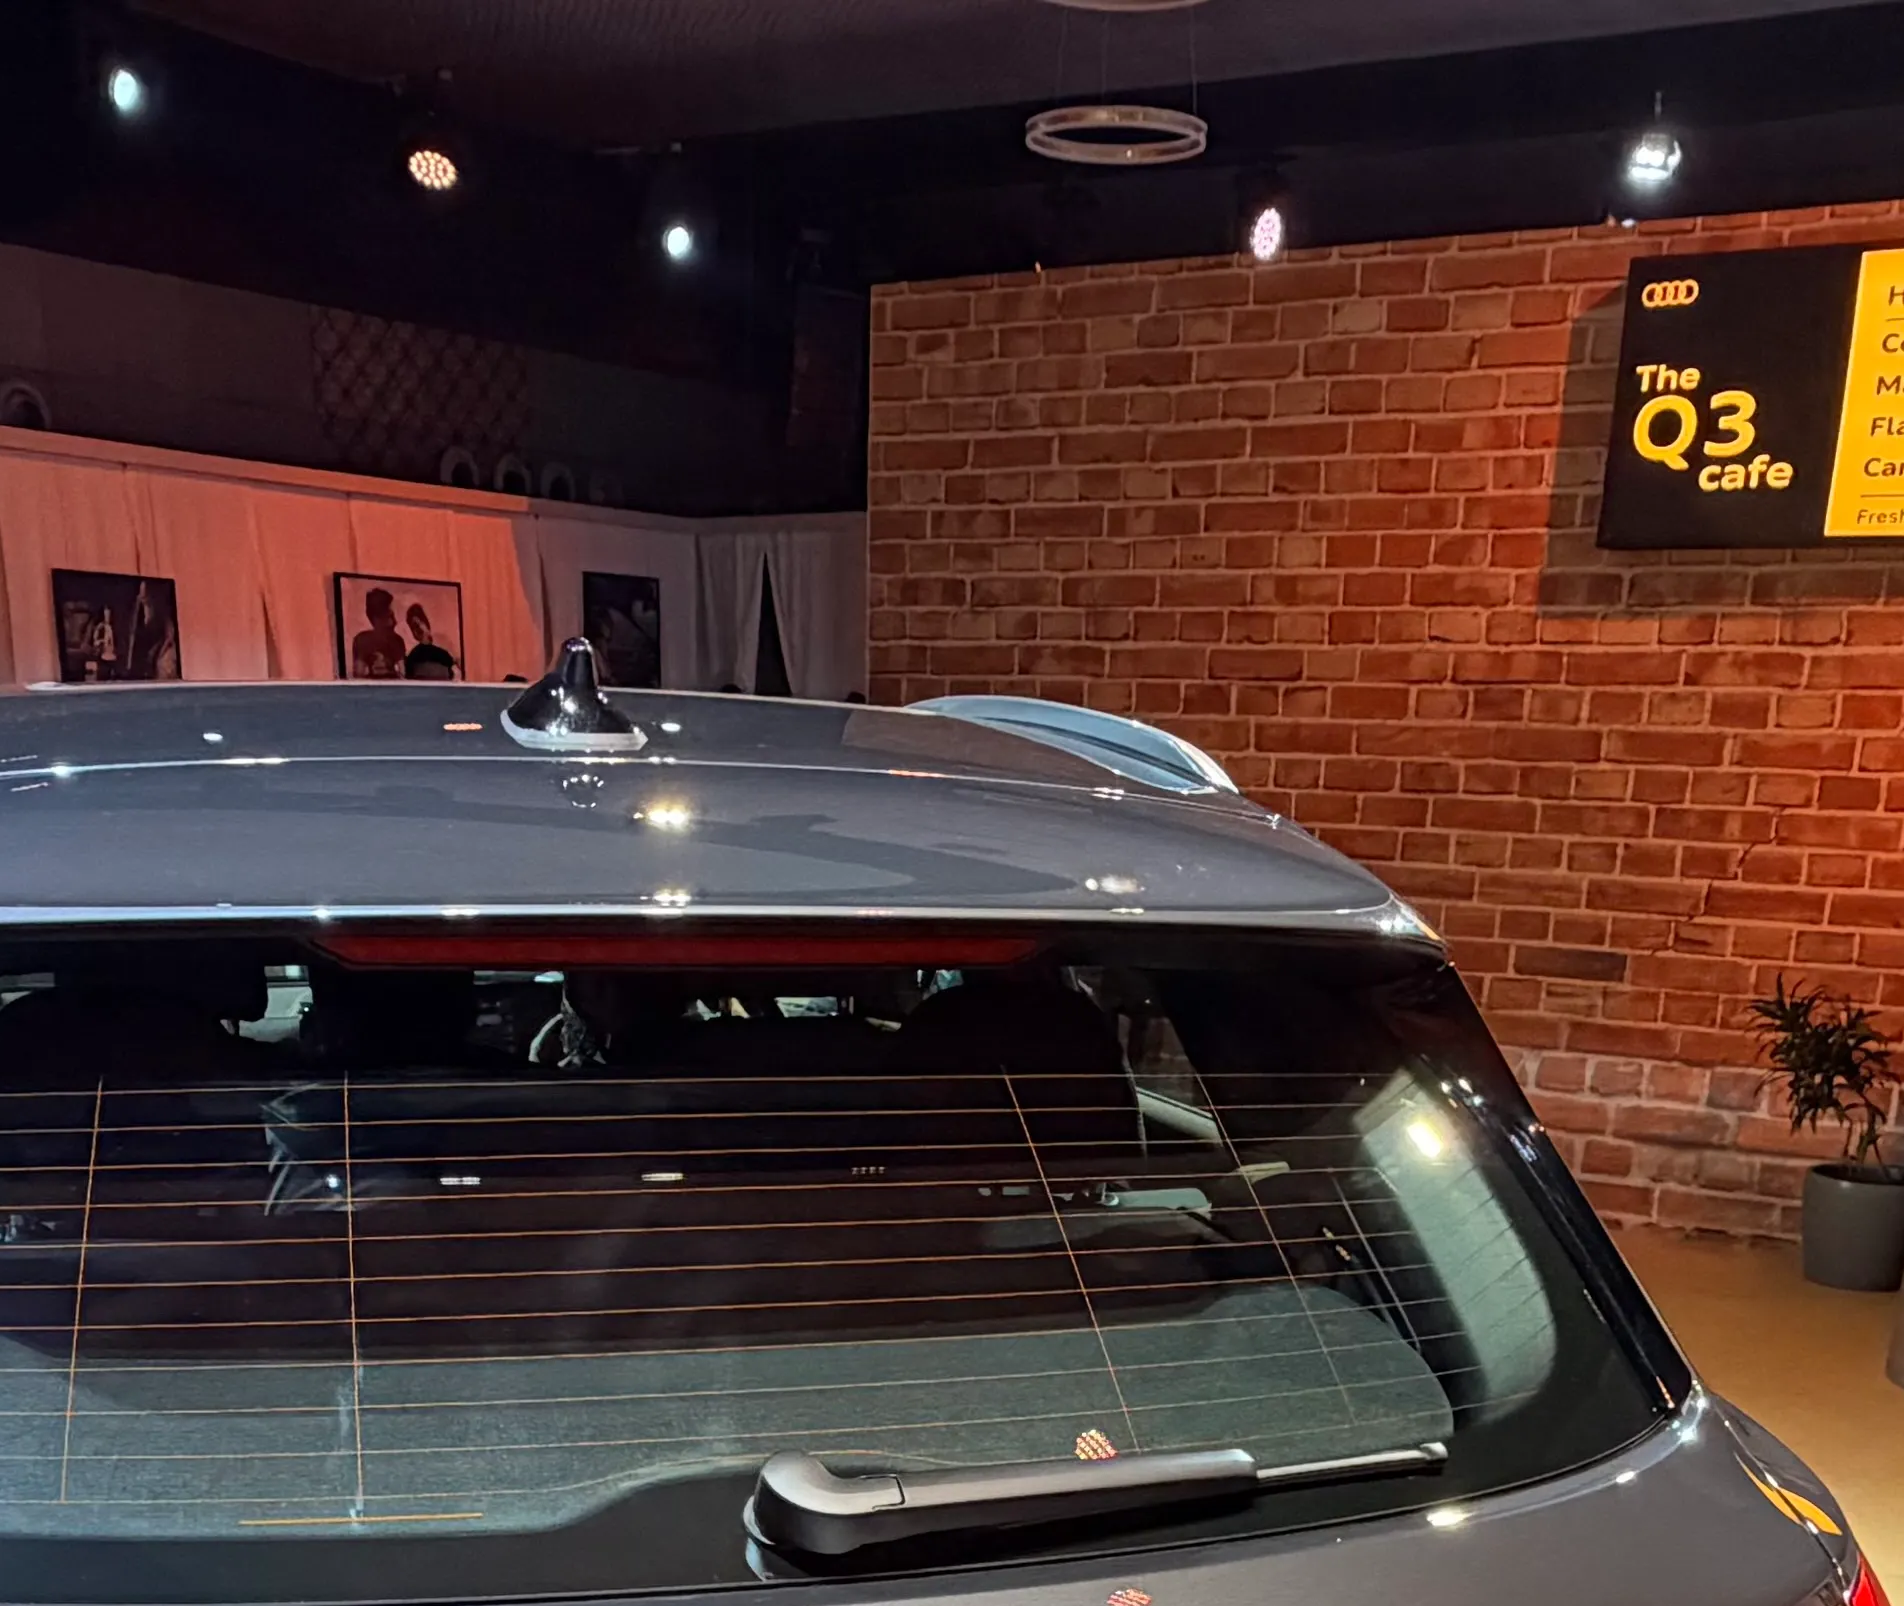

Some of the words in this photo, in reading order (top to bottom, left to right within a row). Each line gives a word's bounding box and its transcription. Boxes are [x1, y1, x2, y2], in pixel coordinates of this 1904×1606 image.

[1636, 364, 1701, 392] The
[1632, 390, 1757, 471] Q3
[1698, 454, 1794, 491] cafe
